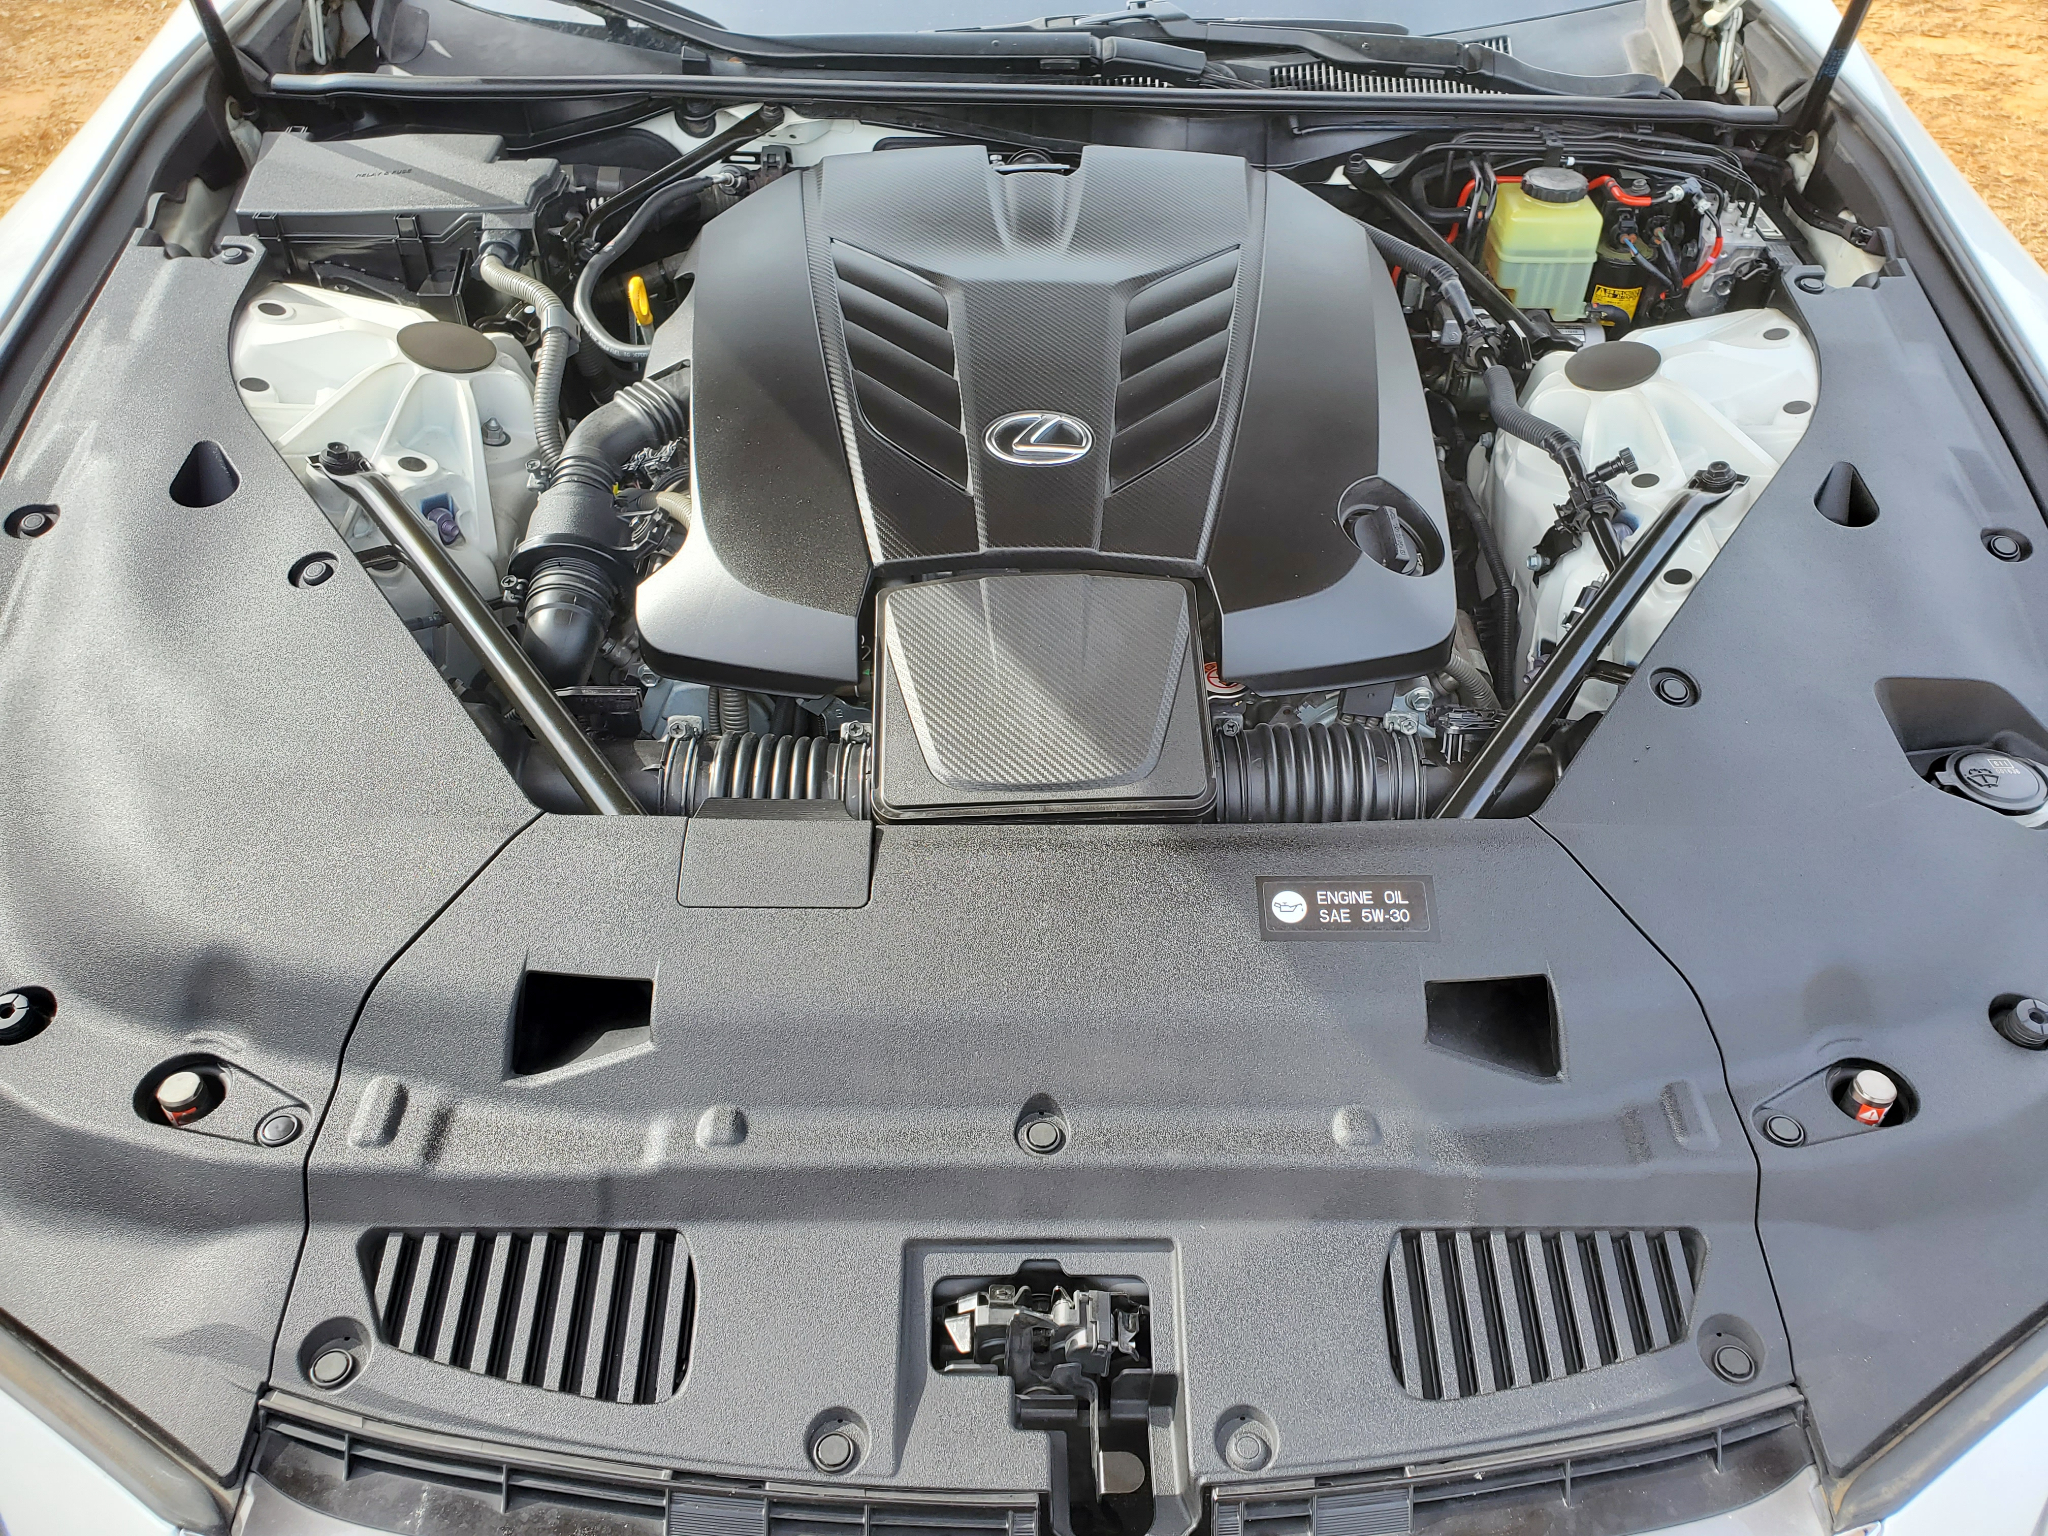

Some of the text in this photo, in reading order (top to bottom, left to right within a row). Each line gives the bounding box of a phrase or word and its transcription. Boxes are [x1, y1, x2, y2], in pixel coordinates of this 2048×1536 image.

[1316, 890, 1409, 905] ENGINE OIL
[1319, 908, 1410, 923] SAE 5W-30
